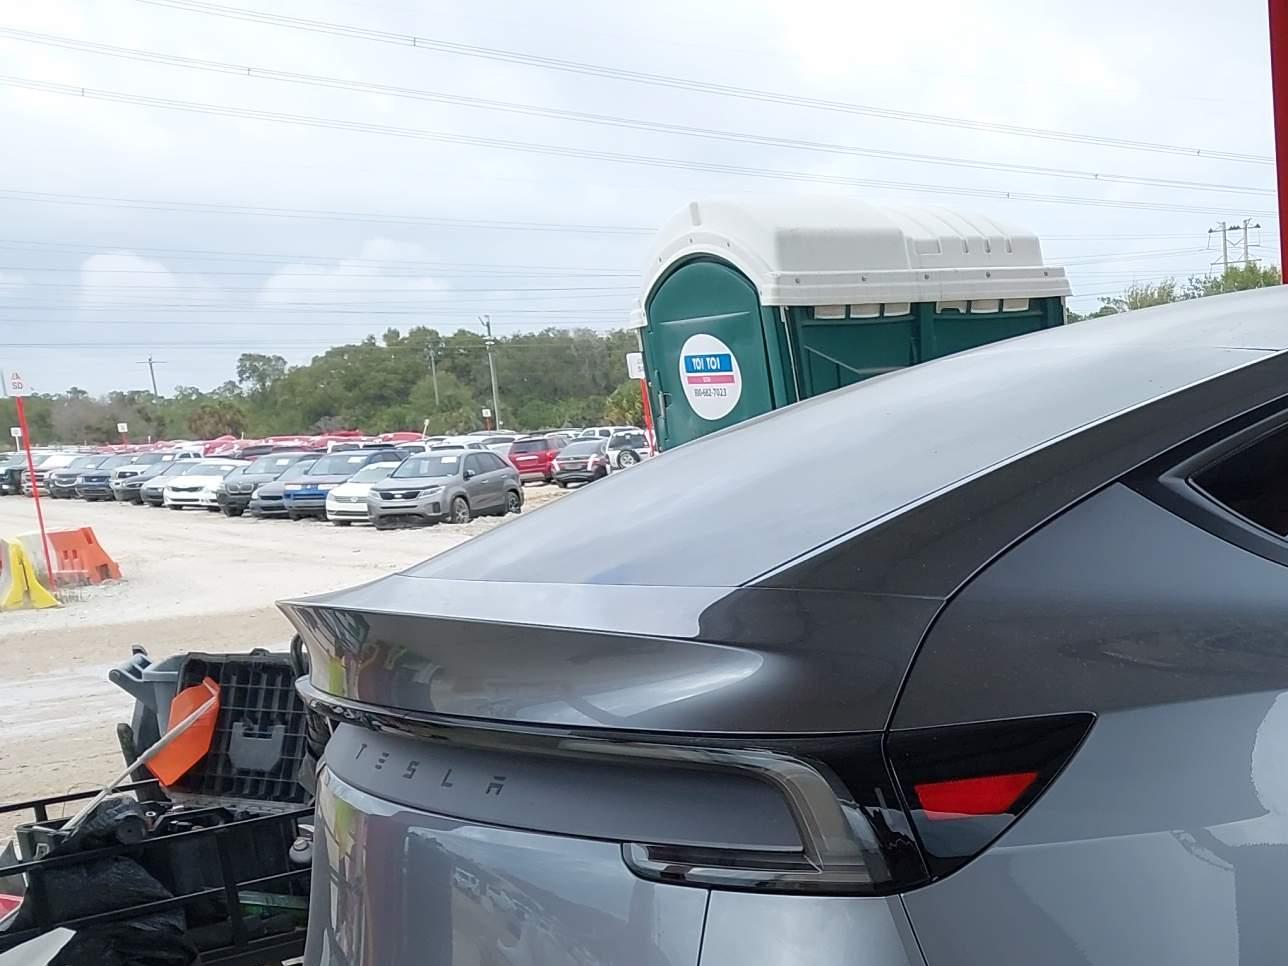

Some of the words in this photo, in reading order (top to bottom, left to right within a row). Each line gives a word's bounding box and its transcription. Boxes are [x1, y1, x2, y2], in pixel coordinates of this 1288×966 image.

[692, 357, 704, 370] TOI
[706, 357, 720, 370] TOI
[355, 743, 507, 796] TESLA
